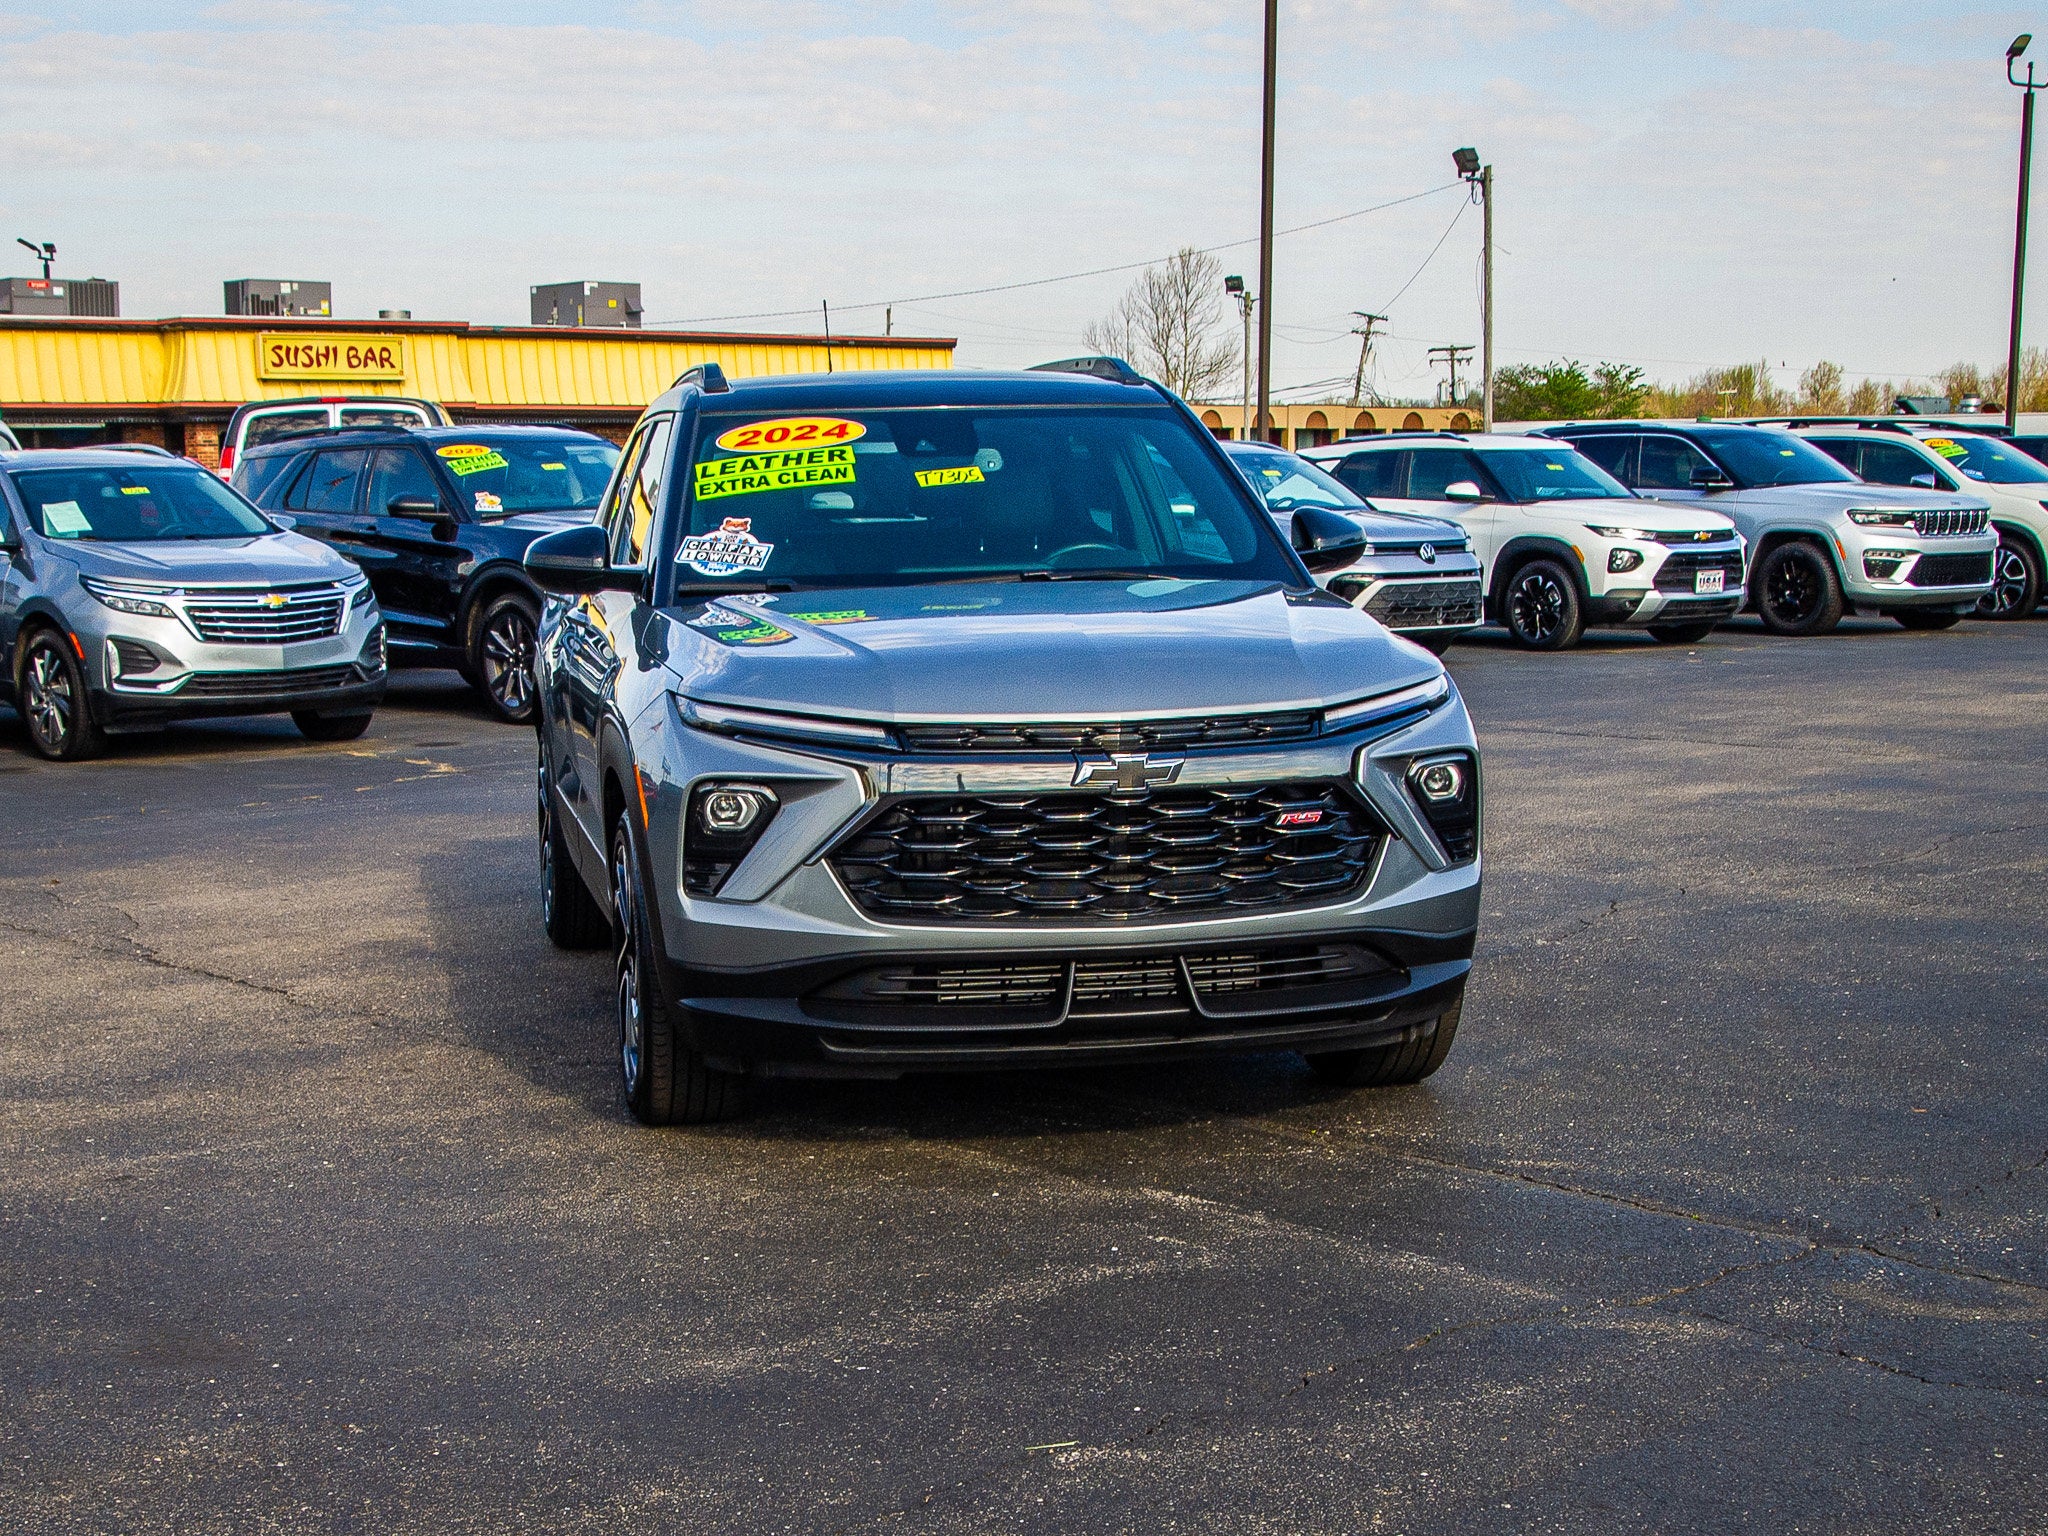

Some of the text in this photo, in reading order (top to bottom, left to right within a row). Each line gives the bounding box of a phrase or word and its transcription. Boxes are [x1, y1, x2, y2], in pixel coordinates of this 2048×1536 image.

[270, 344, 396, 369] SUSHI BAR
[734, 423, 850, 448] 2024
[445, 446, 484, 456] 2025
[450, 454, 498, 468] LEATHER
[700, 450, 848, 480] LEATHER
[699, 467, 848, 497] EXTRA CLEAN
[687, 540, 764, 558] CARFAX
[696, 552, 761, 567] OWNER
[1699, 576, 1721, 588] USA1
